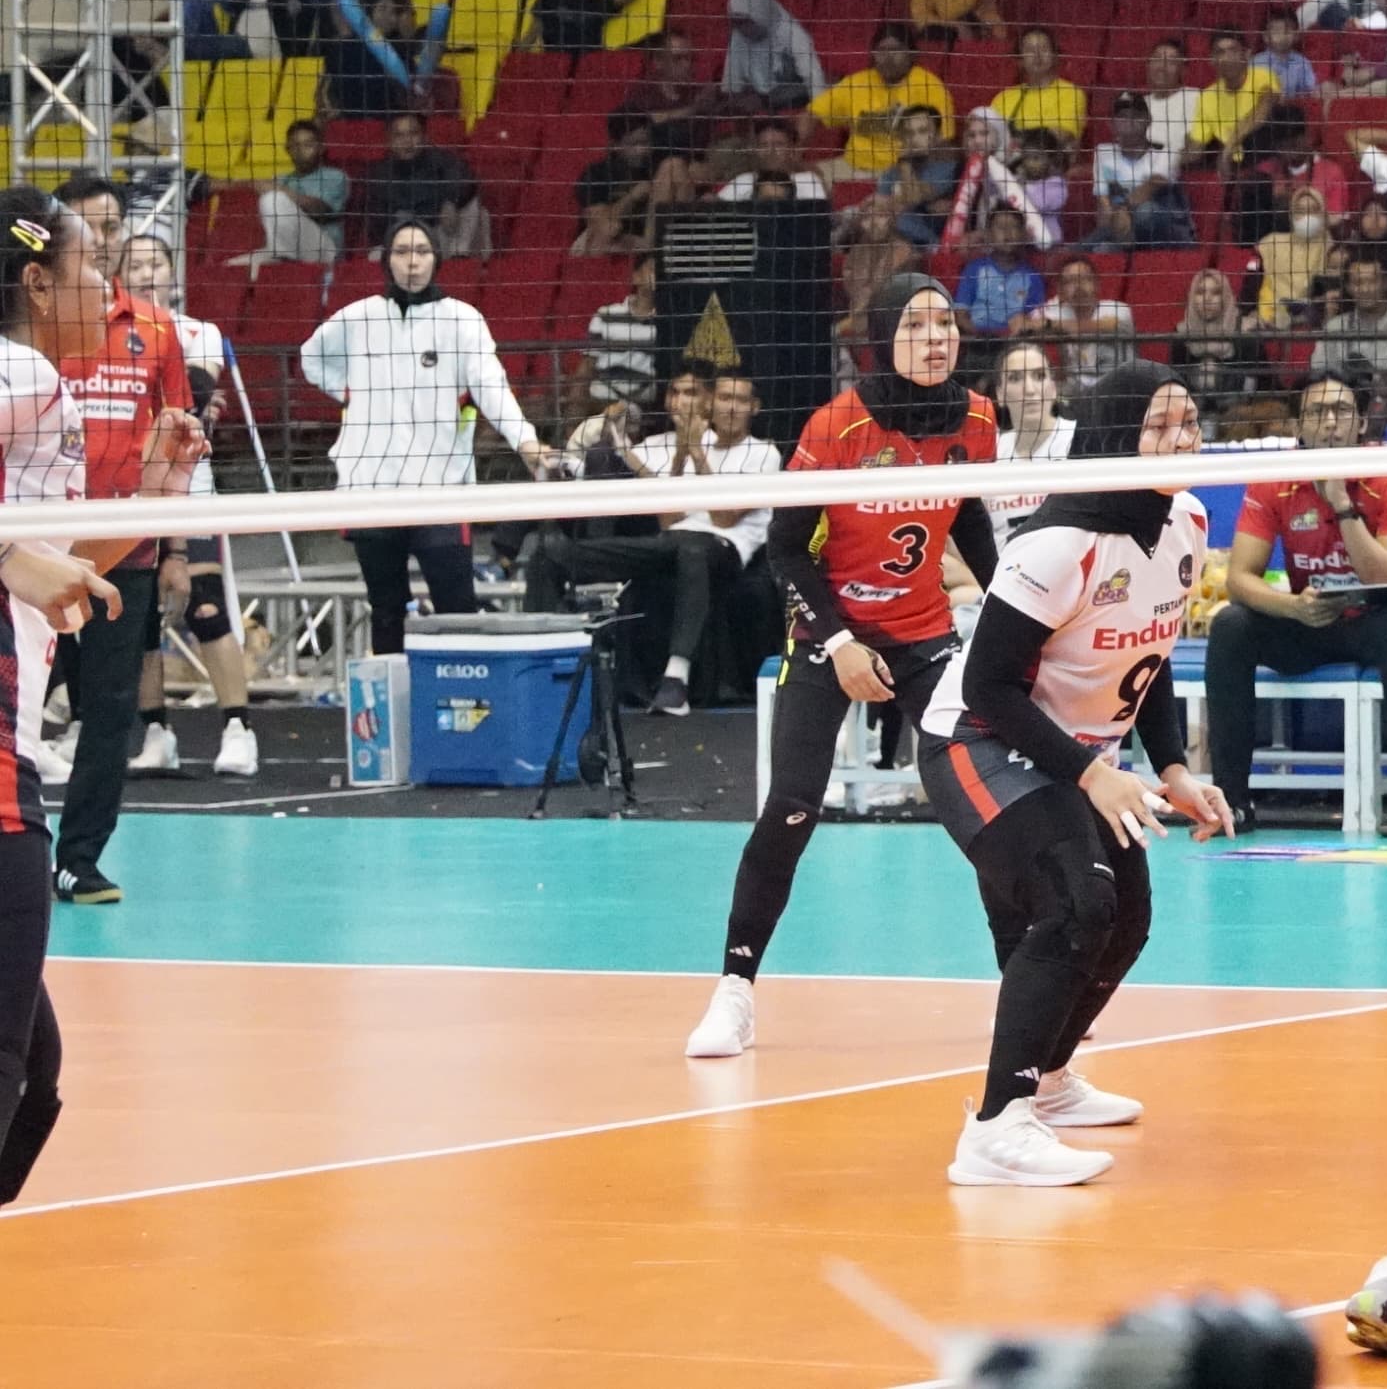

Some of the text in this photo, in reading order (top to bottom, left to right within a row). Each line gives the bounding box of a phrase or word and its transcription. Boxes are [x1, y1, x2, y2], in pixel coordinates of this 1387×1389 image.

[61, 373, 147, 395] nduro
[880, 521, 930, 578] 3
[1110, 653, 1163, 722] 9
